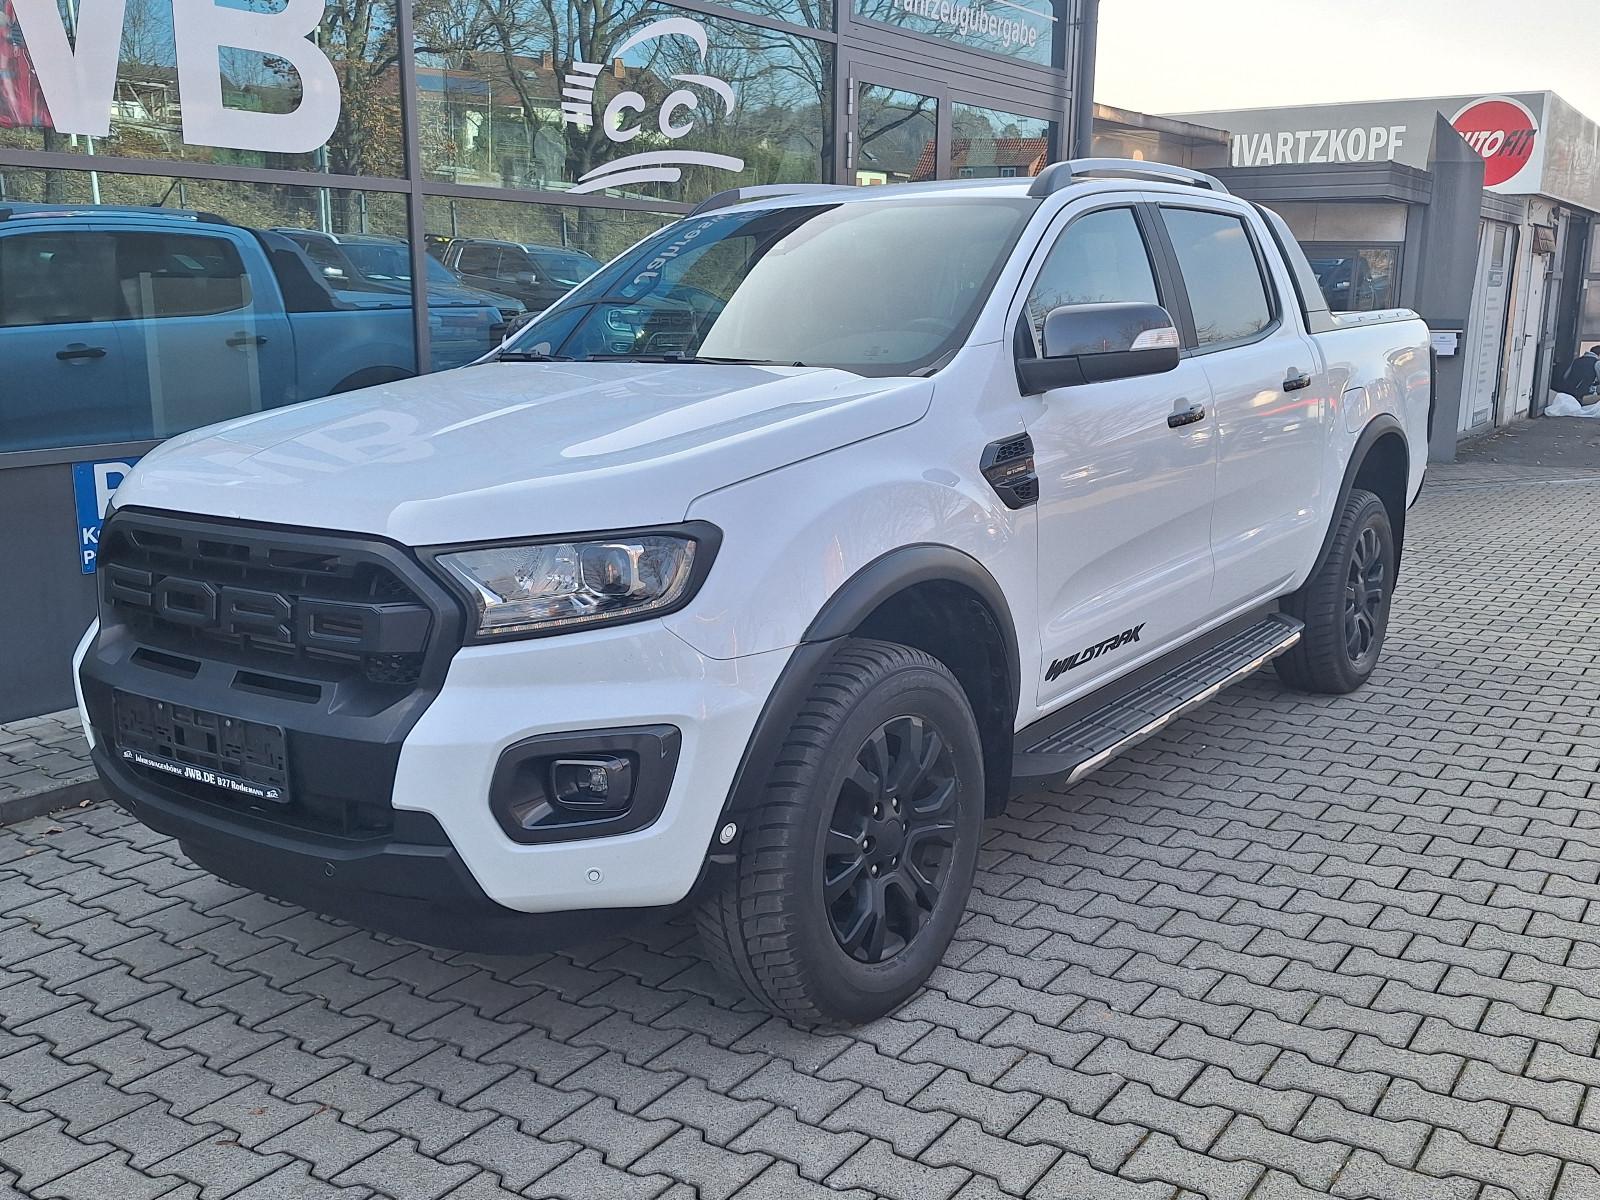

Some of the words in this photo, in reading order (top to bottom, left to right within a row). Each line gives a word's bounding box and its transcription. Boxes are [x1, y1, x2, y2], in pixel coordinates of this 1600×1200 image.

[1459, 129, 1537, 157] TOFIT
[82, 526, 100, 544] K
[83, 550, 96, 564] P
[104, 562, 381, 652] FORD
[1044, 622, 1146, 682] WILDTRAK
[184, 767, 216, 784] JWB.DE
[217, 777, 231, 789] B27
